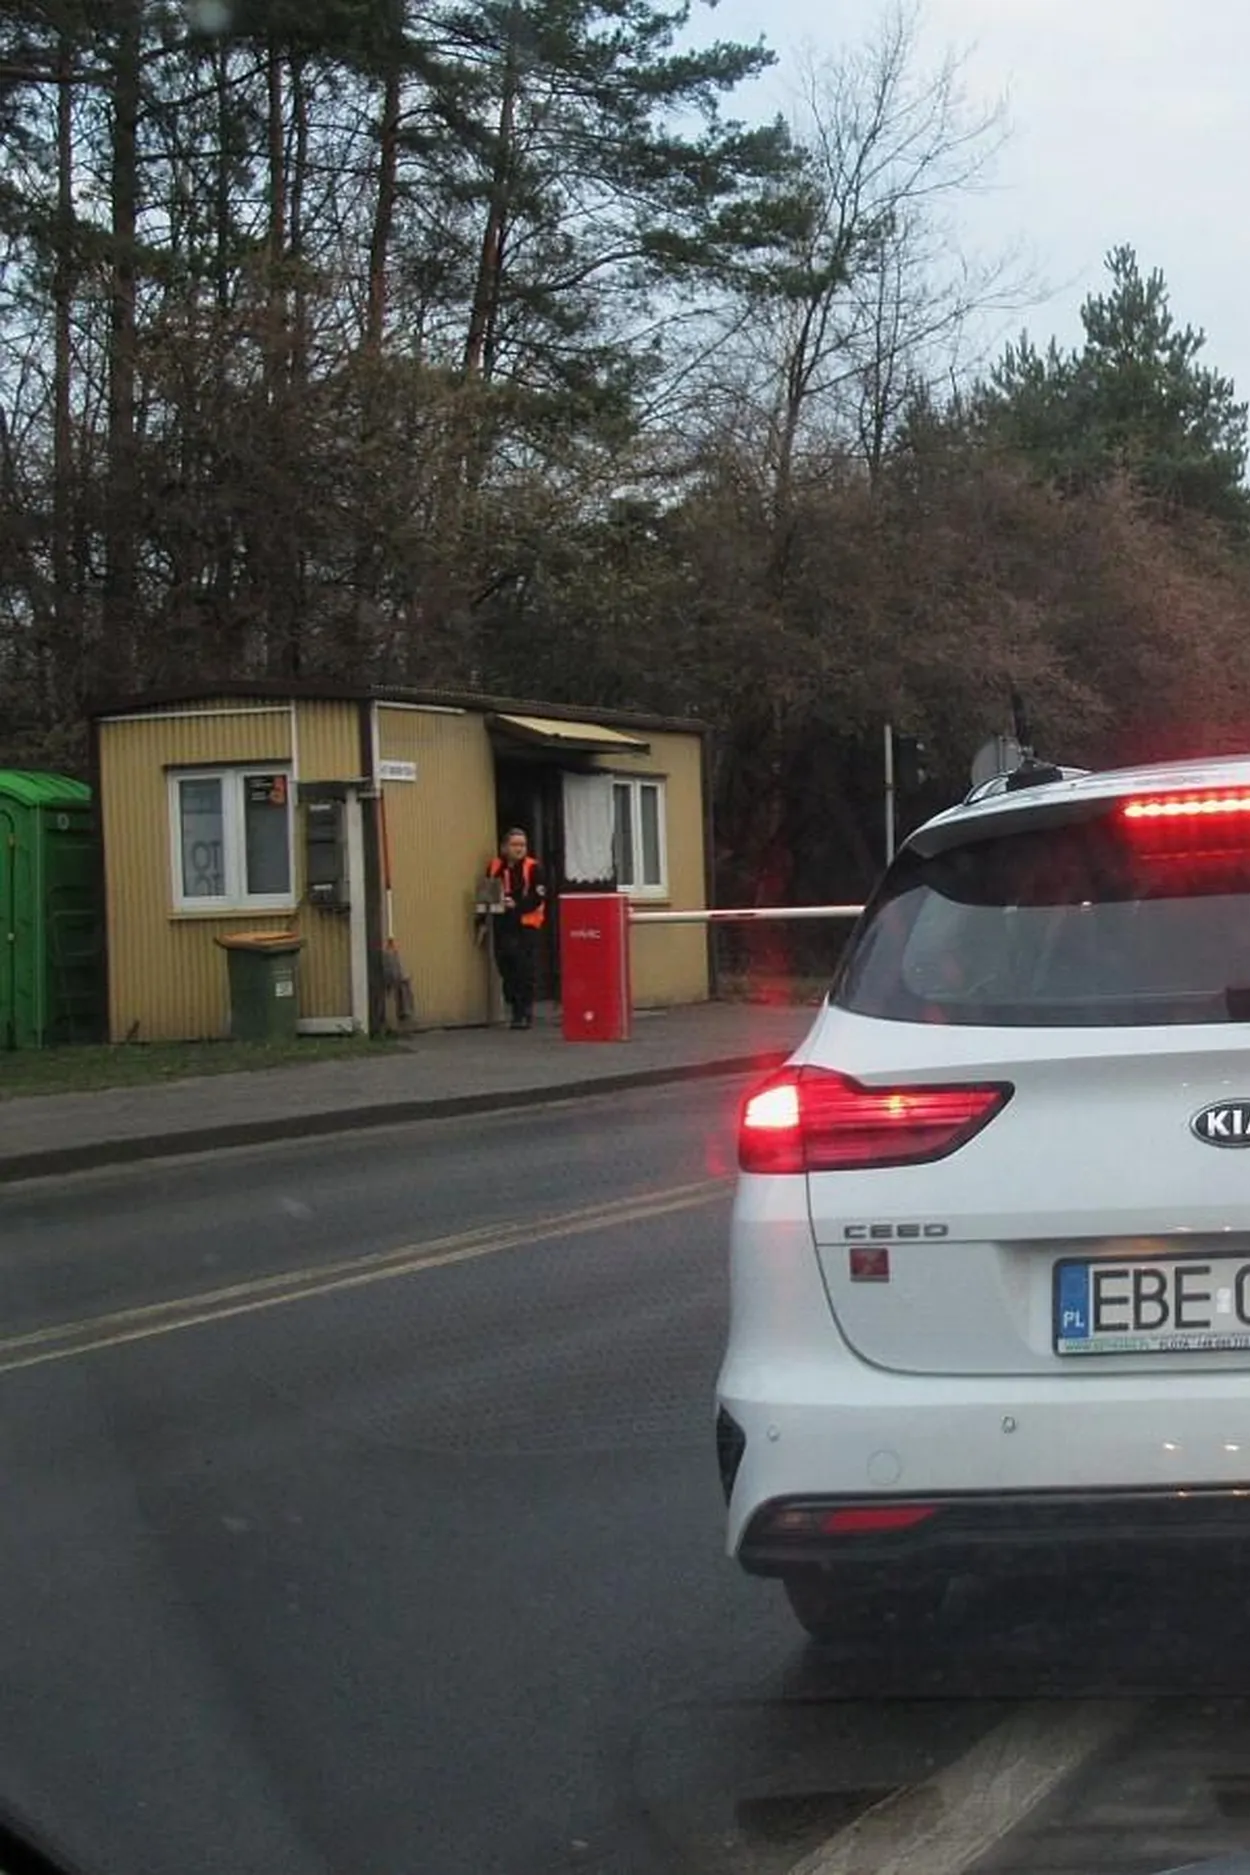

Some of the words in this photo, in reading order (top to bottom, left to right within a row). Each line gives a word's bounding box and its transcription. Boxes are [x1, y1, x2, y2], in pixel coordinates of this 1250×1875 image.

[844, 1224, 948, 1239] CEED
[1093, 1265, 1212, 1333] EBE
[1063, 1310, 1085, 1328] PL
